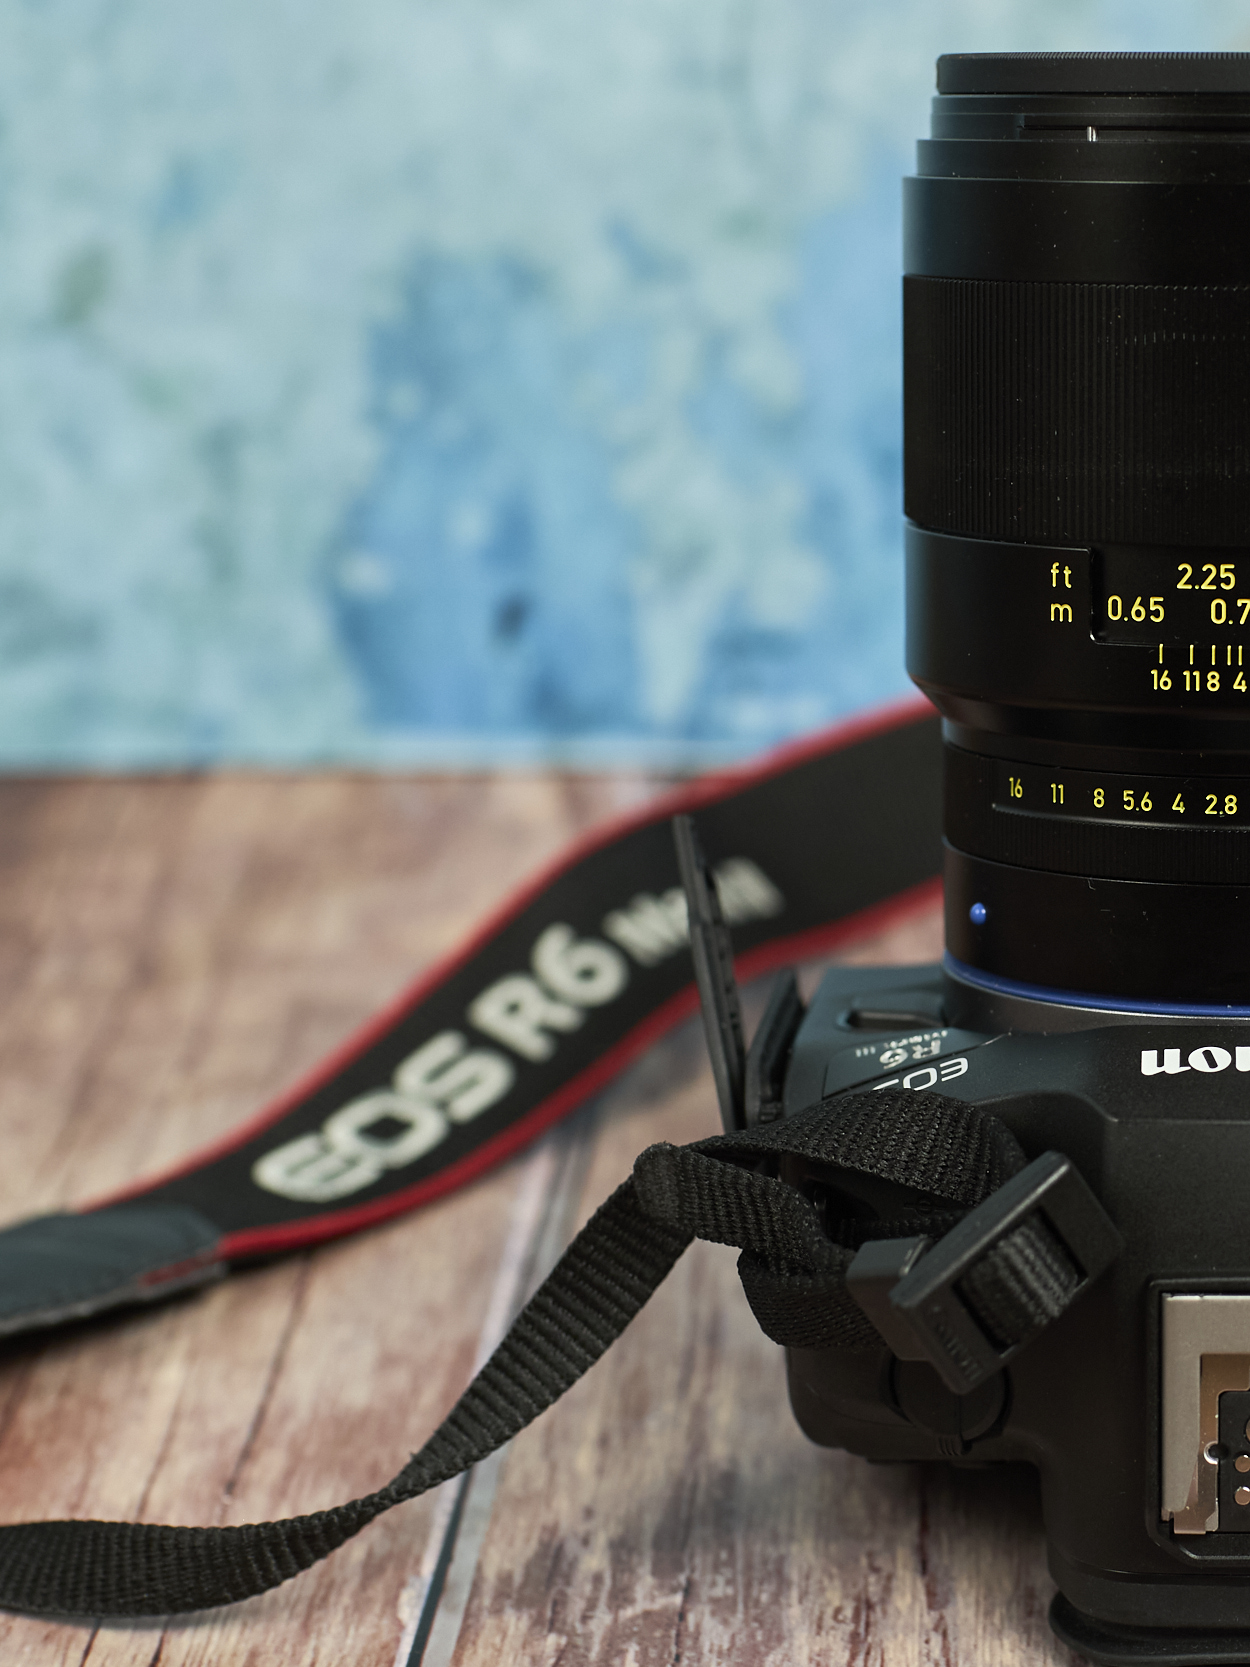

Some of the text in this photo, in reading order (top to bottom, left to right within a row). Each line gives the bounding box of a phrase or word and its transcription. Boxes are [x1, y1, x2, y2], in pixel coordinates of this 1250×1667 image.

[1050, 561, 1072, 589] ft
[1176, 563, 1236, 591] 2.25
[1050, 603, 1073, 623] m
[1107, 594, 1165, 623] 0.65
[1150, 669, 1172, 691] 16
[1182, 670, 1201, 692] 11
[1206, 670, 1221, 692] 8
[1232, 671, 1248, 693] 4
[1008, 777, 1023, 799] 16
[1050, 783, 1064, 805] 11
[1093, 787, 1105, 809] 8
[1123, 789, 1153, 812] 5.6
[1171, 792, 1186, 814] 4
[1204, 793, 1238, 815] 2.8
[251, 921, 629, 1203] EOS R6
[879, 1039, 941, 1070] R6
[872, 1057, 969, 1091] EO
